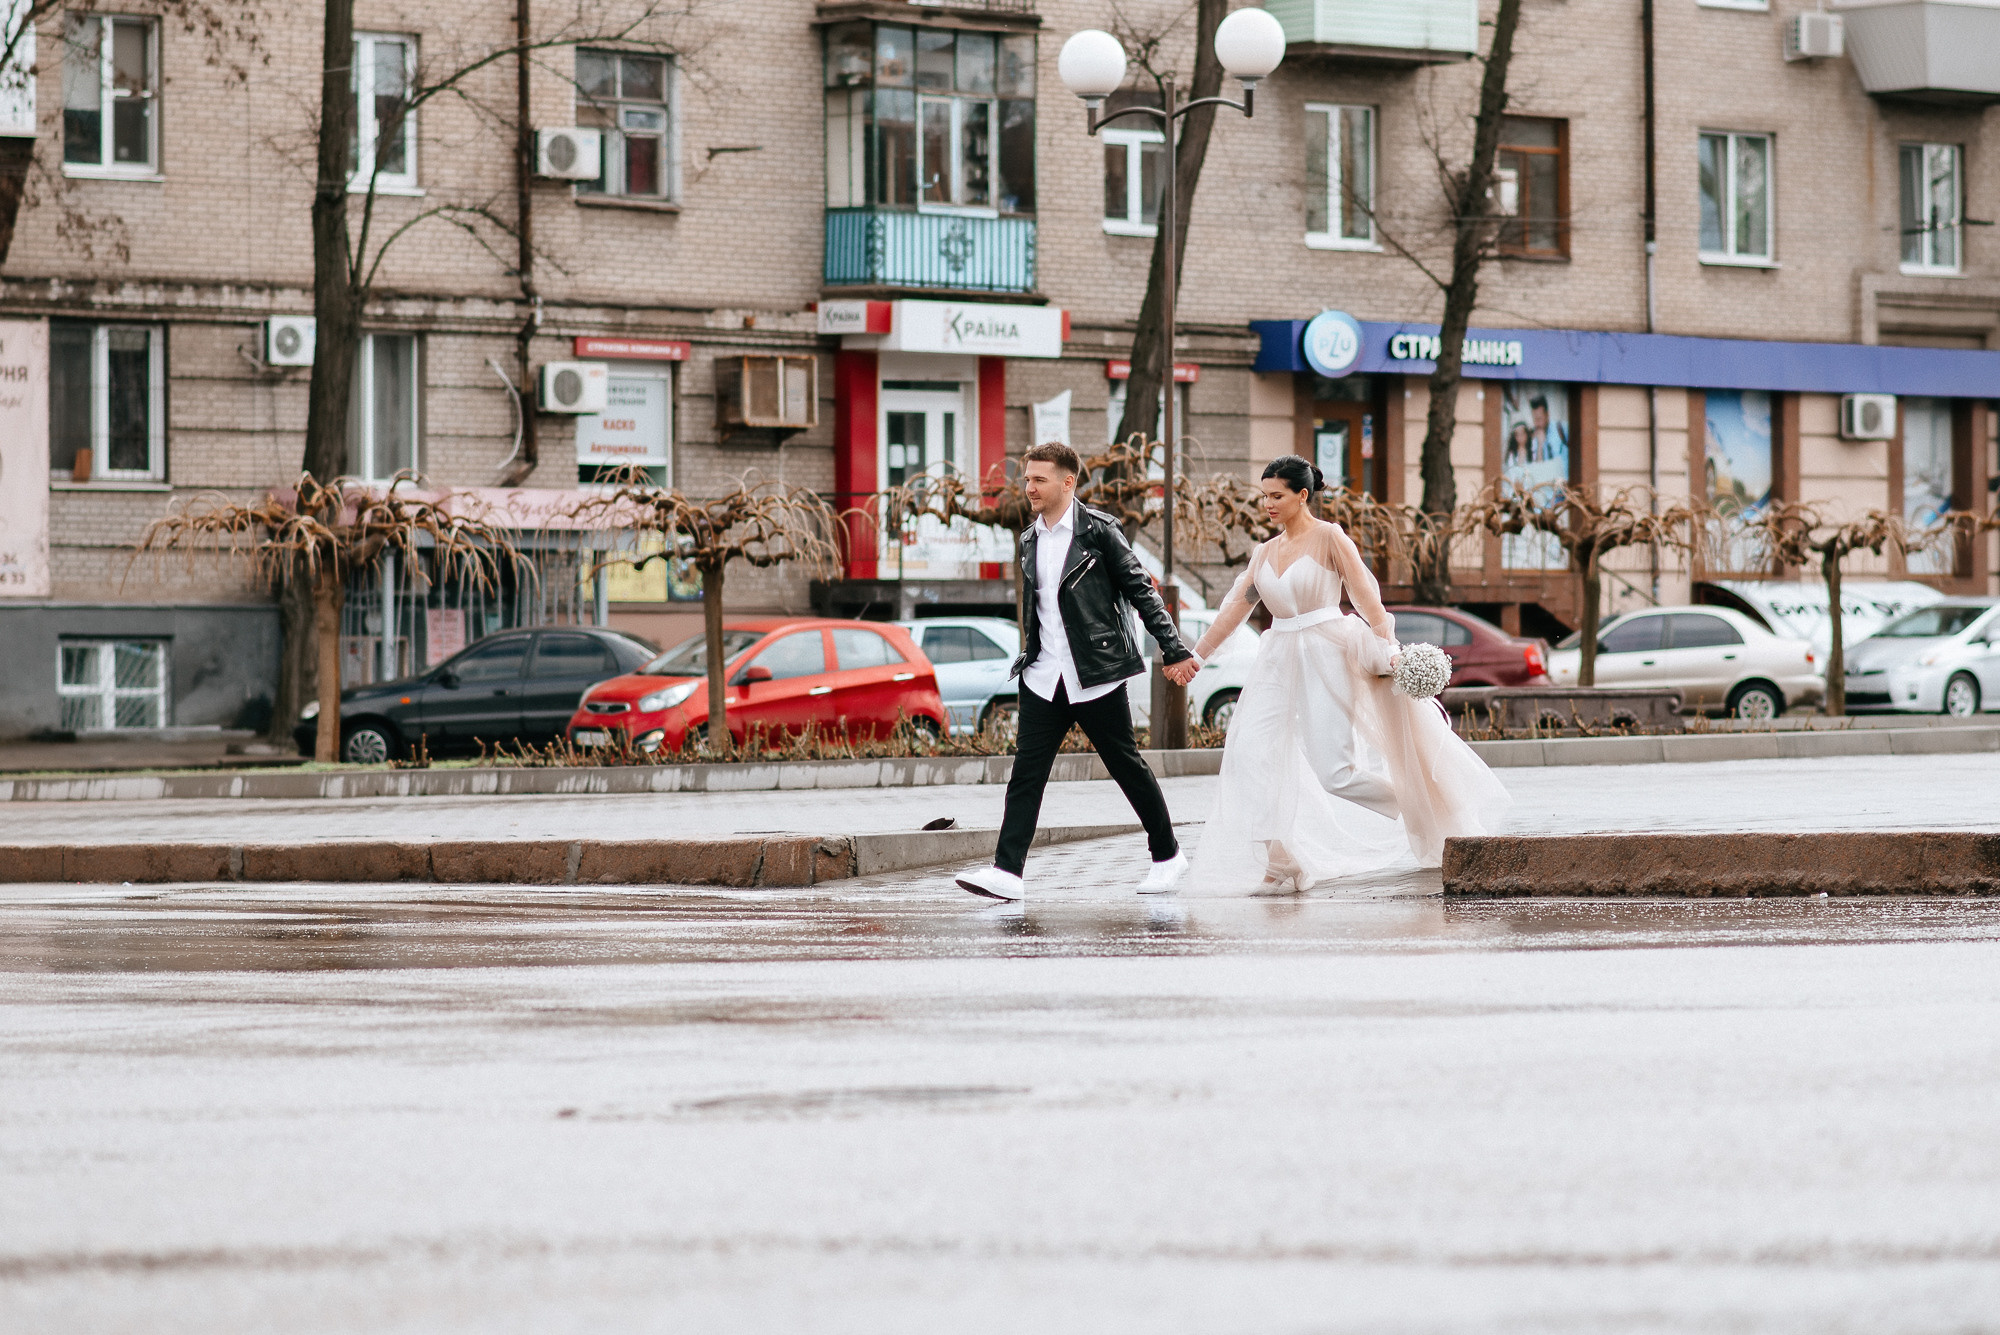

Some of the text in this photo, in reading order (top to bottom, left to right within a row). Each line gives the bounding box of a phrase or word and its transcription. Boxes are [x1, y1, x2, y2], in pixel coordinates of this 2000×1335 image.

[944, 308, 1020, 346] КРАЇНА
[1319, 331, 1352, 359] PZU
[1391, 334, 1523, 366] СТРАВАННЯ
[603, 419, 636, 431] КАСКО
